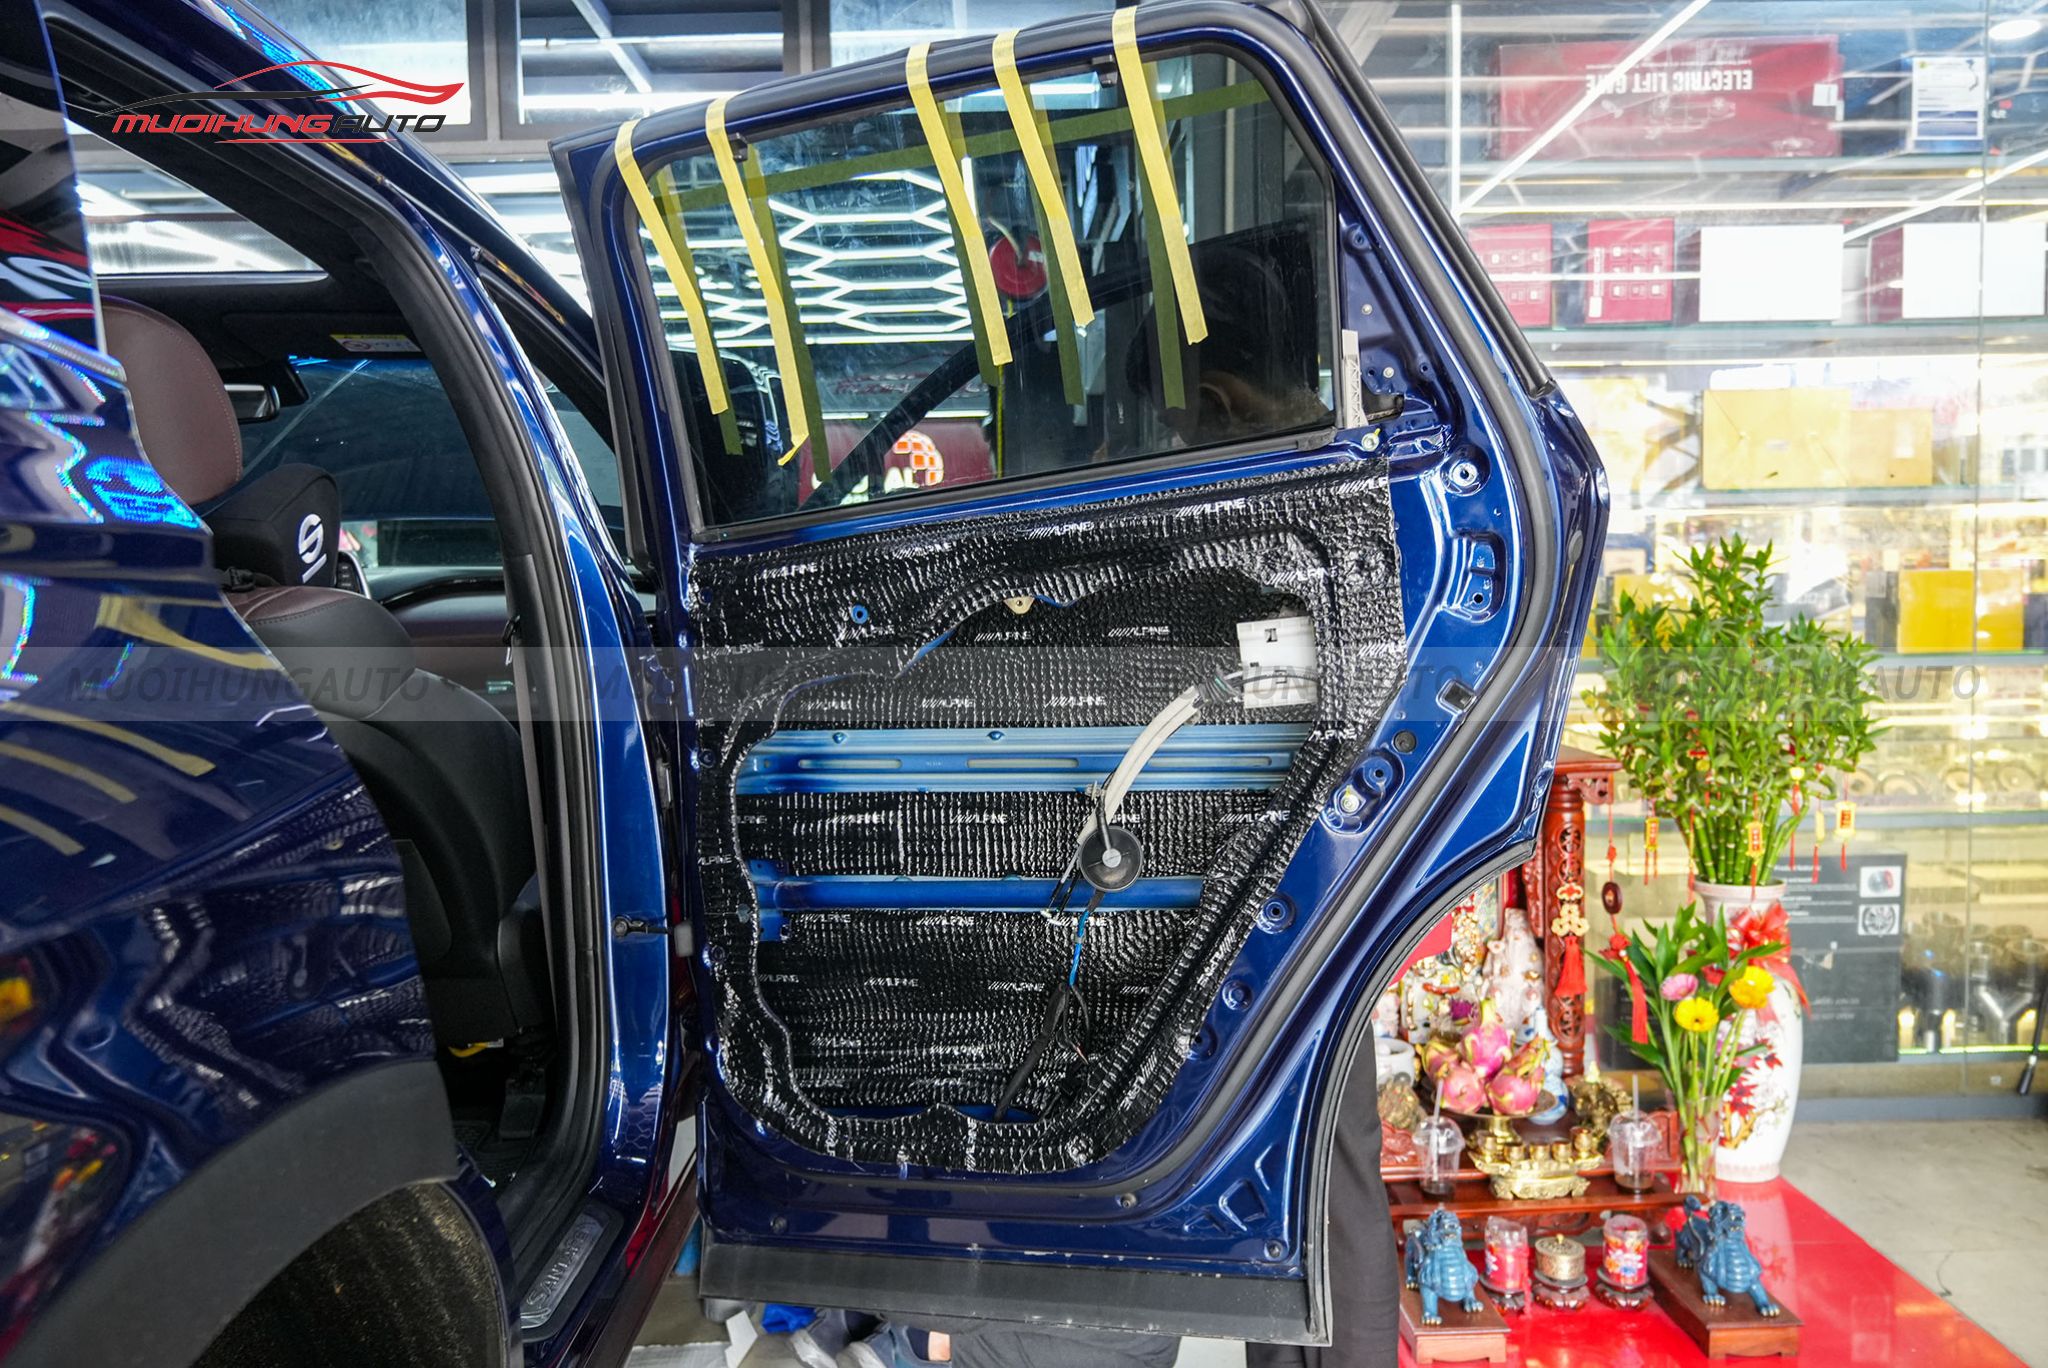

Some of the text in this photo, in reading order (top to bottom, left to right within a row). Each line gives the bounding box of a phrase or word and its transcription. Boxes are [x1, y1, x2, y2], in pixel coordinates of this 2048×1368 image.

[1631, 71, 1668, 93] LIFT
[1672, 69, 1753, 92] ELECTRIC
[1200, 497, 1247, 514] ALPINE
[1052, 520, 1094, 536] ALPINE
[780, 561, 819, 577] ALPINE
[970, 813, 1009, 824] ALPINE
[698, 853, 733, 866] ALPINE
